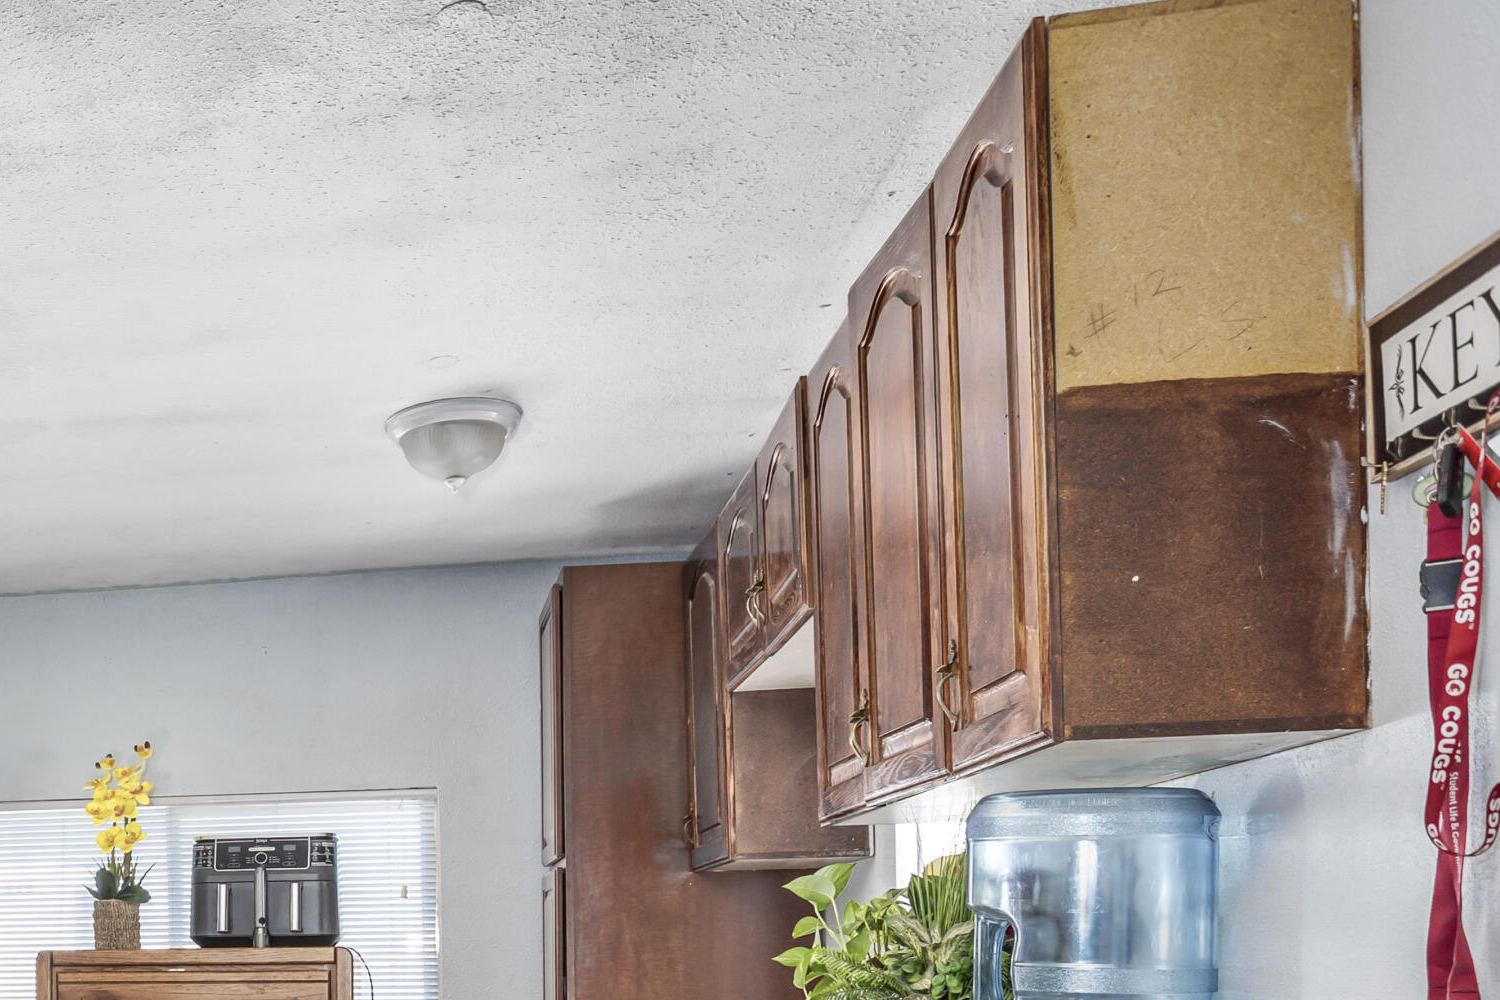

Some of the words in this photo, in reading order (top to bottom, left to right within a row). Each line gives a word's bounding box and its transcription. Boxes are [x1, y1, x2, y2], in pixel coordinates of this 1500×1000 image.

[1469, 502, 1481, 536] GO
[1455, 545, 1481, 624] COUGS
[1445, 663, 1468, 696] GO
[1431, 705, 1461, 784] COUGS
[1449, 771, 1458, 805] Student
[1449, 807, 1459, 822] Life
